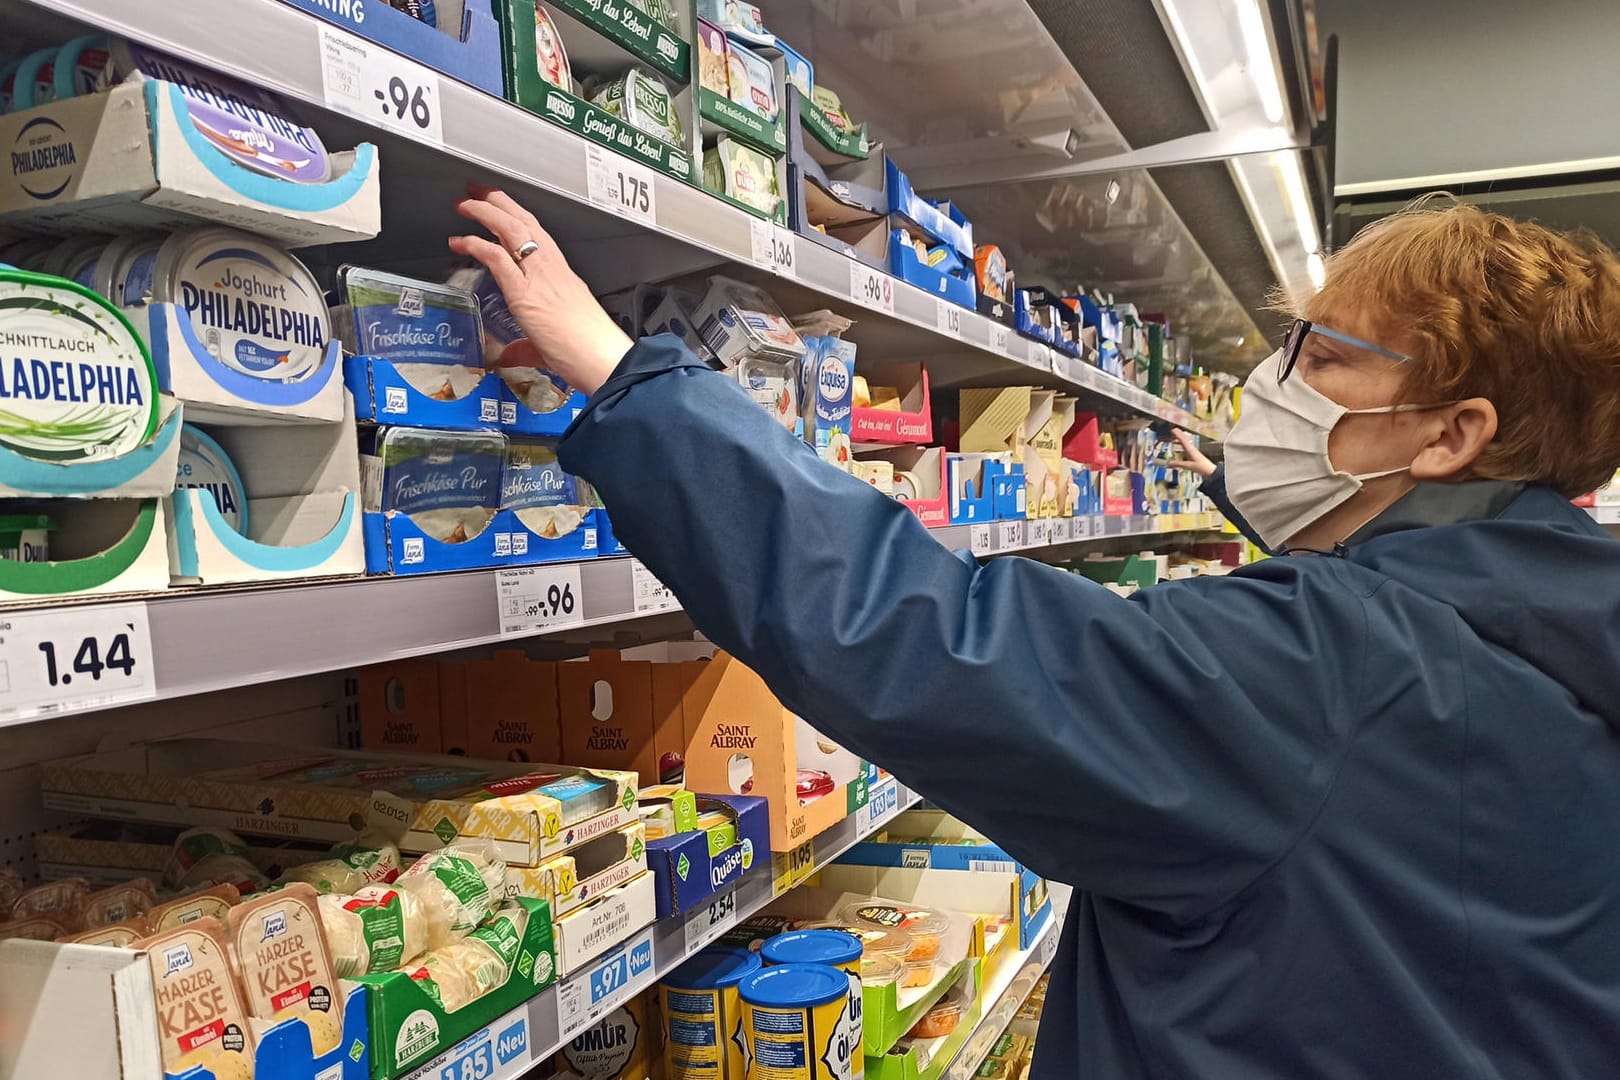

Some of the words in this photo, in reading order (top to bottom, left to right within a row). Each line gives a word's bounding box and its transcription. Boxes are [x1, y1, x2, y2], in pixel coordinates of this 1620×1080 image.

[620, 7, 651, 40] Leben!
[635, 82, 666, 117] BRESSO
[583, 110, 617, 142] Genieß
[618, 129, 633, 147] das
[634, 132, 662, 161] Leben!
[11, 142, 76, 176] PHILADELPHIA
[618, 172, 649, 213] 1.75
[221, 268, 287, 301] Joghurt
[181, 281, 324, 349] PHILADELPHIA
[0, 332, 95, 353] CHNITTLAUCH
[368, 321, 435, 351] Frischkäse
[436, 322, 464, 347] Pur
[0, 356, 143, 406] LADELPHIA
[821, 366, 845, 392] Exquisa
[896, 416, 927, 436] Géramont
[396, 472, 458, 504] Frischkäse
[460, 466, 487, 490] Pur
[503, 475, 542, 497] schkäse
[541, 470, 565, 491] Pur
[39, 634, 135, 686] 1.44
[492, 731, 535, 744] ALBRAY
[498, 720, 528, 731] SAINT
[592, 726, 622, 738] SAINT
[717, 723, 750, 736] SAINT
[586, 737, 630, 750] ALBRAY
[710, 735, 757, 748] ALBRAY
[576, 815, 620, 841] HARZINGER
[792, 815, 805, 827] SAINT
[712, 850, 742, 886] Quäse
[791, 842, 811, 872] 1.95
[590, 866, 630, 894] HARZINGER
[709, 891, 734, 925] 2.54
[256, 935, 305, 966] HARZER
[632, 949, 650, 968] Neu
[157, 968, 215, 1006] HARZER
[257, 951, 317, 997] KÄSE
[159, 985, 228, 1039] KÄSE
[501, 1031, 526, 1058] Neu
